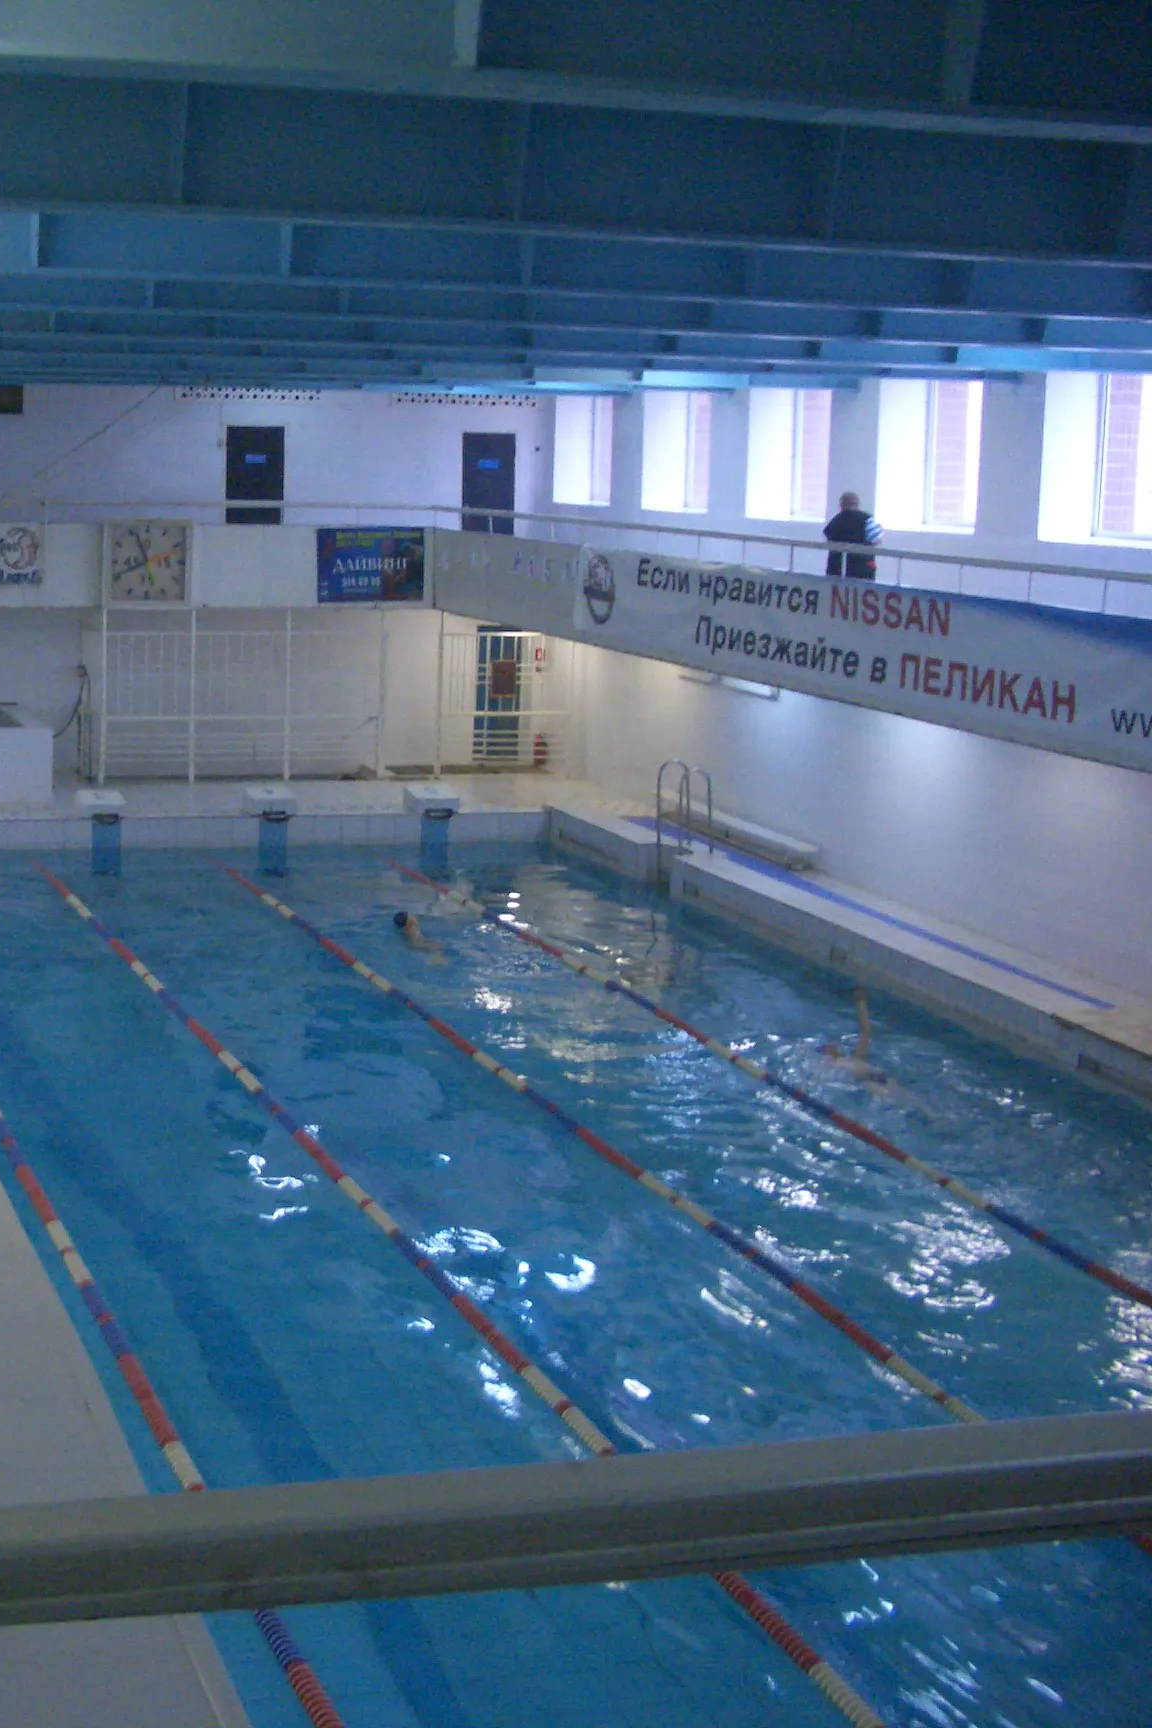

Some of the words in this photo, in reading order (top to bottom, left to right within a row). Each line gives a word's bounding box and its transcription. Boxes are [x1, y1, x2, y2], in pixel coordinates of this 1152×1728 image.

[636, 558, 690, 595] Если
[698, 569, 820, 615] нравится
[830, 584, 951, 636] NISSAN
[694, 614, 859, 677] Приезжайте
[869, 655, 888, 683] в
[900, 653, 1076, 723] ПЕЛИКАН
